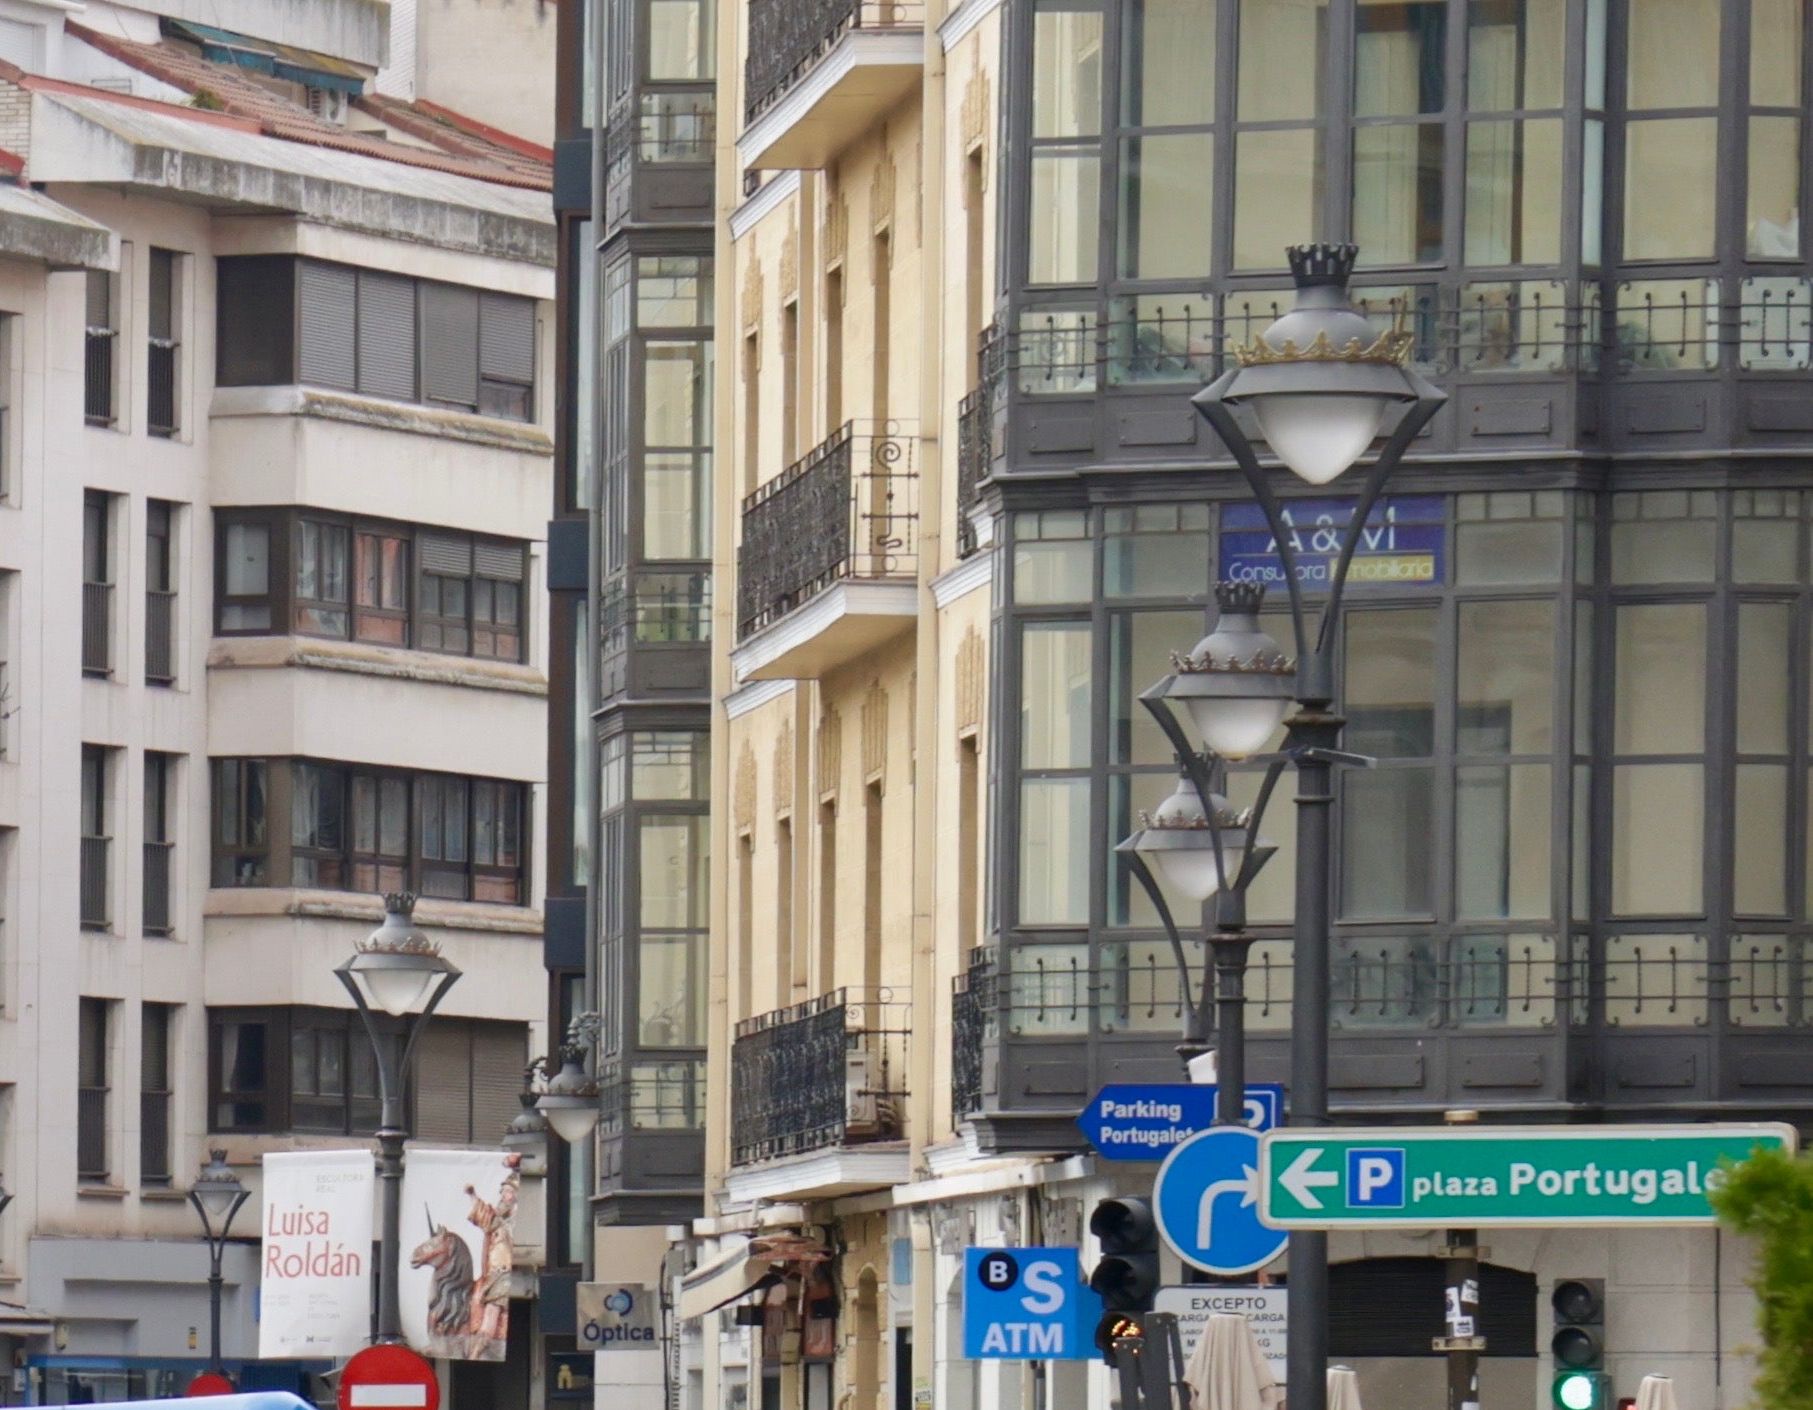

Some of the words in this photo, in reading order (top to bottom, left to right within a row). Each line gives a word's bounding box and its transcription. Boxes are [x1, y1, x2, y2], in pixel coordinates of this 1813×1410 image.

[1229, 562, 1326, 582] Consuora
[1330, 557, 1433, 580] Imobiliaria
[1100, 1100, 1182, 1123] Parking
[1100, 1126, 1194, 1148] Portugalet
[1359, 1157, 1393, 1201] P
[1412, 1172, 1498, 1202] plaza
[1509, 1161, 1730, 1205] Portugale
[268, 1203, 329, 1236] Luisa
[265, 1241, 361, 1279] Roldán
[988, 1260, 1009, 1283] B
[1020, 1260, 1065, 1315] S
[1191, 1297, 1267, 1310] EXCEPTO
[583, 1318, 655, 1346] Óptica
[1178, 1314, 1210, 1322] ARGA
[981, 1322, 1063, 1353] ATM
